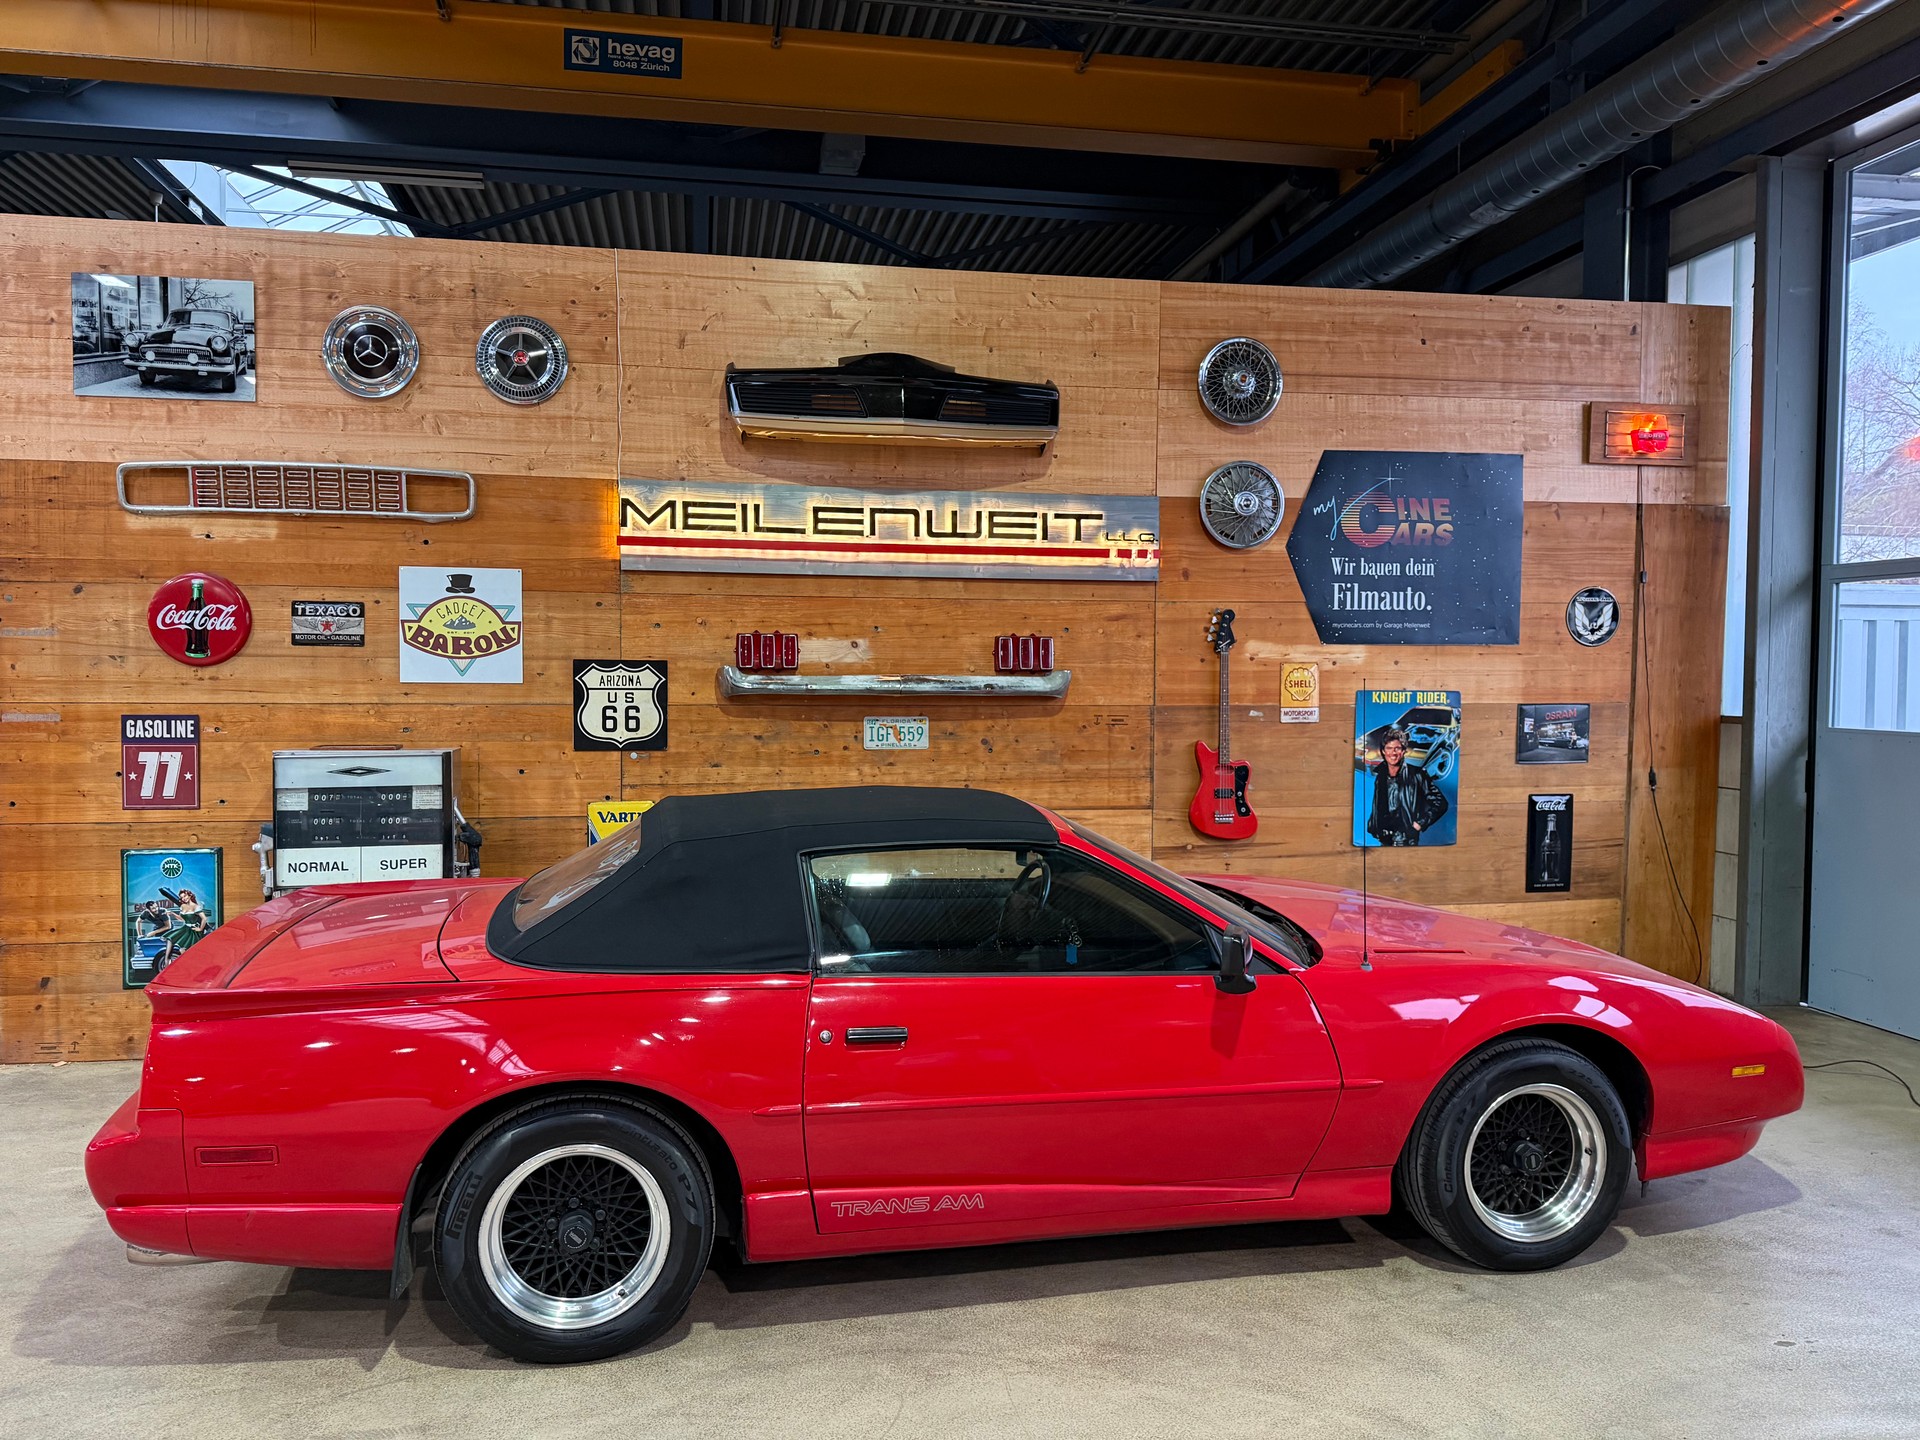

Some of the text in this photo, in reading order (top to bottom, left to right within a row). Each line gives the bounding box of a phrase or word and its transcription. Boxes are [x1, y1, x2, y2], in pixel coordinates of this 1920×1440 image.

[607, 38, 676, 62] hevag
[613, 60, 670, 72] 8048 Zürich
[1331, 557, 1435, 576] Wir bauen dein
[1331, 582, 1432, 611] Filmauto.
[156, 603, 239, 631] Coca-Cola
[294, 604, 361, 617] TEXACO
[436, 602, 486, 619] GADGET
[408, 624, 517, 655] BARON
[599, 675, 642, 687] ARIZONA
[1289, 679, 1313, 688] SHELL
[1372, 691, 1413, 705] KNIGHT
[601, 705, 641, 733] 66
[1544, 708, 1577, 720] OSRAM
[125, 719, 195, 739] GASOLINE
[1535, 799, 1567, 811] Coca-Cola
[287, 860, 349, 873] NORMAL
[379, 857, 428, 871] SUPER
[445, 1169, 483, 1240] PIRELLI
[830, 1192, 985, 1217] TRANS AM
